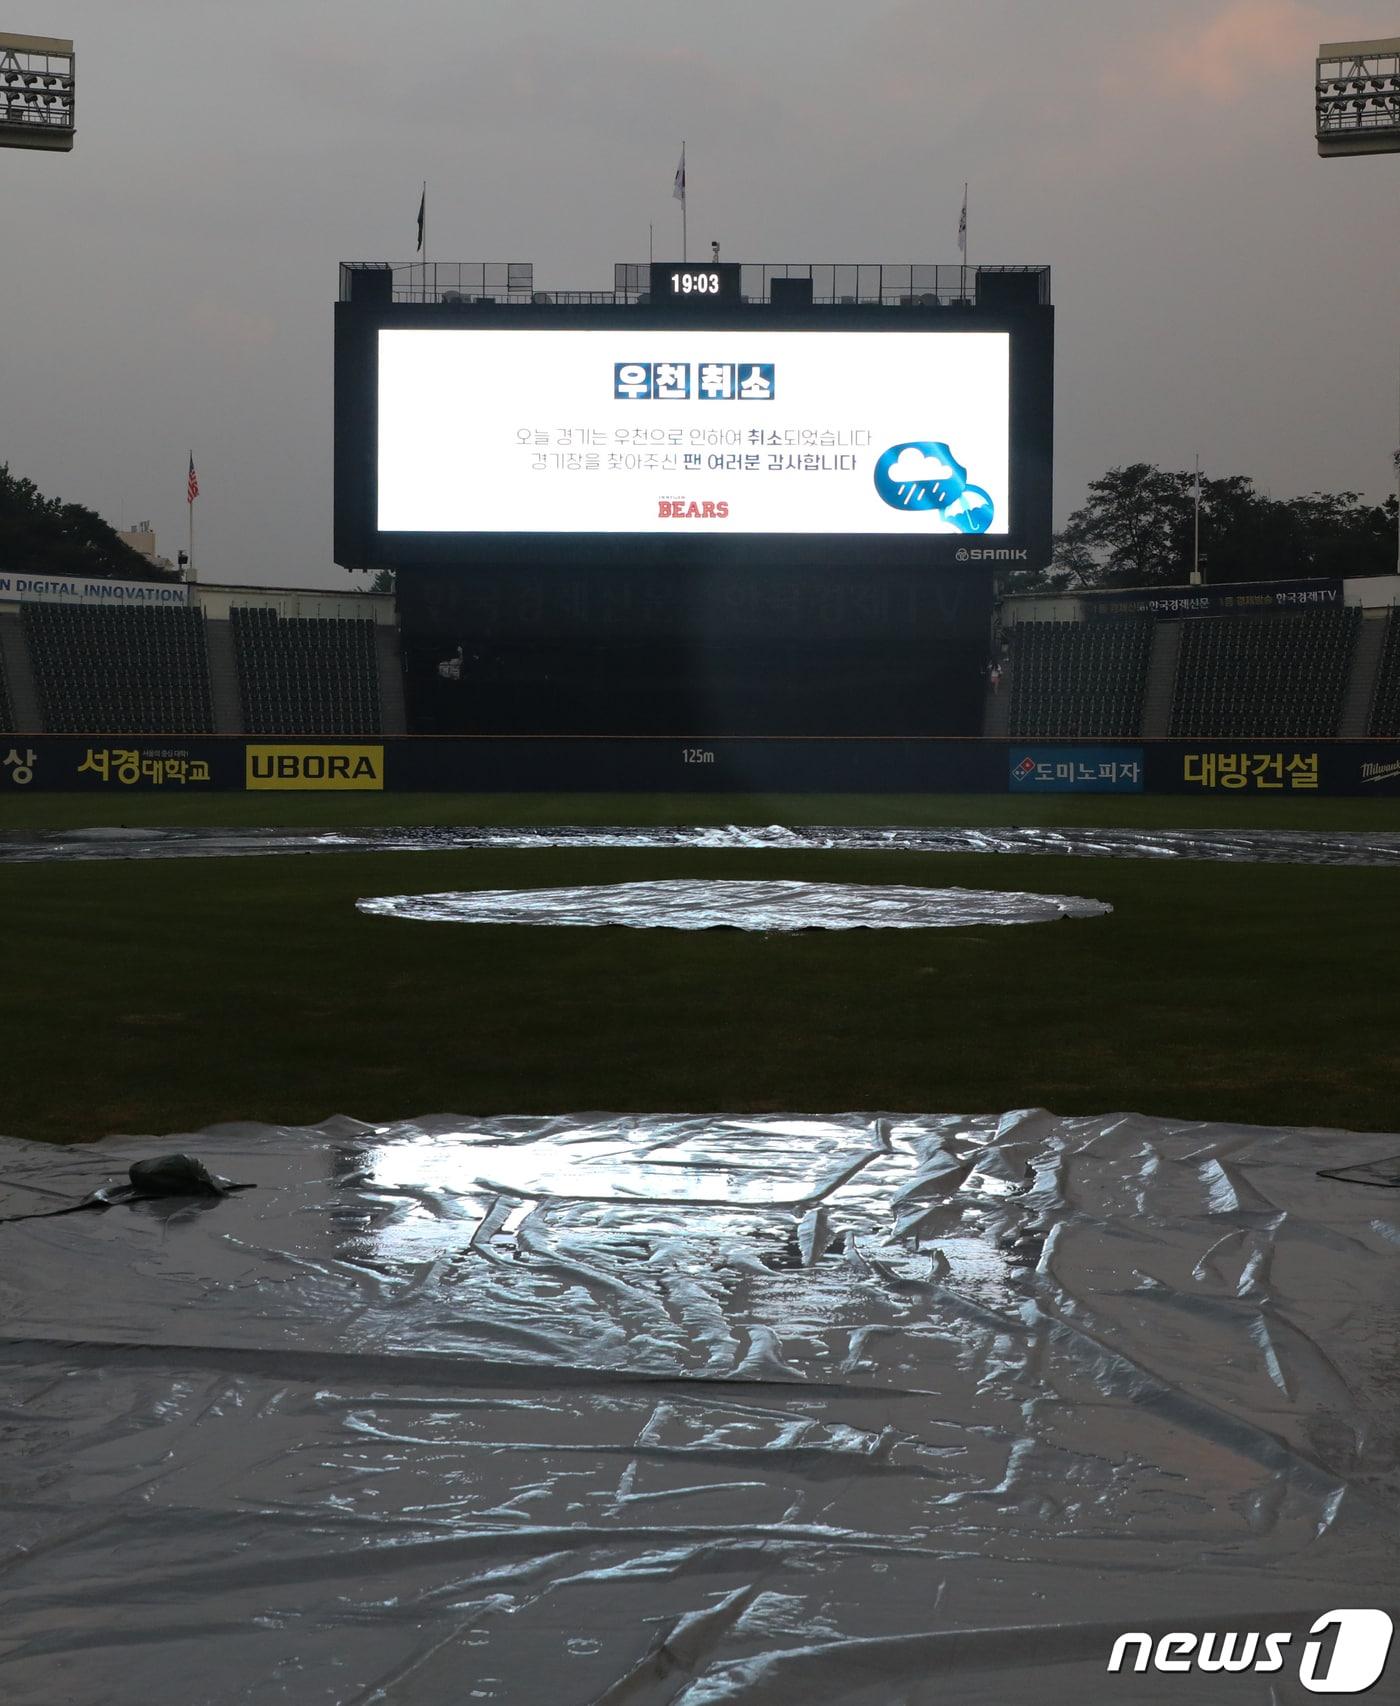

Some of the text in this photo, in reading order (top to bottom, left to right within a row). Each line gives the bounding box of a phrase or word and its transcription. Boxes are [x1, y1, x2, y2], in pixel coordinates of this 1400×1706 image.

[671, 273, 719, 293] 19:03
[615, 363, 774, 400] 우천 취소
[515, 428, 872, 446] 오늘 경기는 우천으로 인하여 취소되었습니다
[531, 453, 857, 471] 경기장을 찾아주신 팬 여러분 감사합니다
[658, 501, 729, 518] BEARS
[970, 549, 1028, 560] SAMIK
[16, 579, 79, 596] DIGITAL
[84, 584, 184, 602] INNOVATION
[1276, 589, 1337, 605] 한국경제TV
[1148, 597, 1209, 612] 한국경제신문
[682, 749, 714, 763] 125m
[77, 748, 211, 785] 서경대학교
[251, 755, 377, 779] UBORA
[1034, 760, 1141, 784] 도미노피자
[1183, 752, 1319, 789] 대방건설
